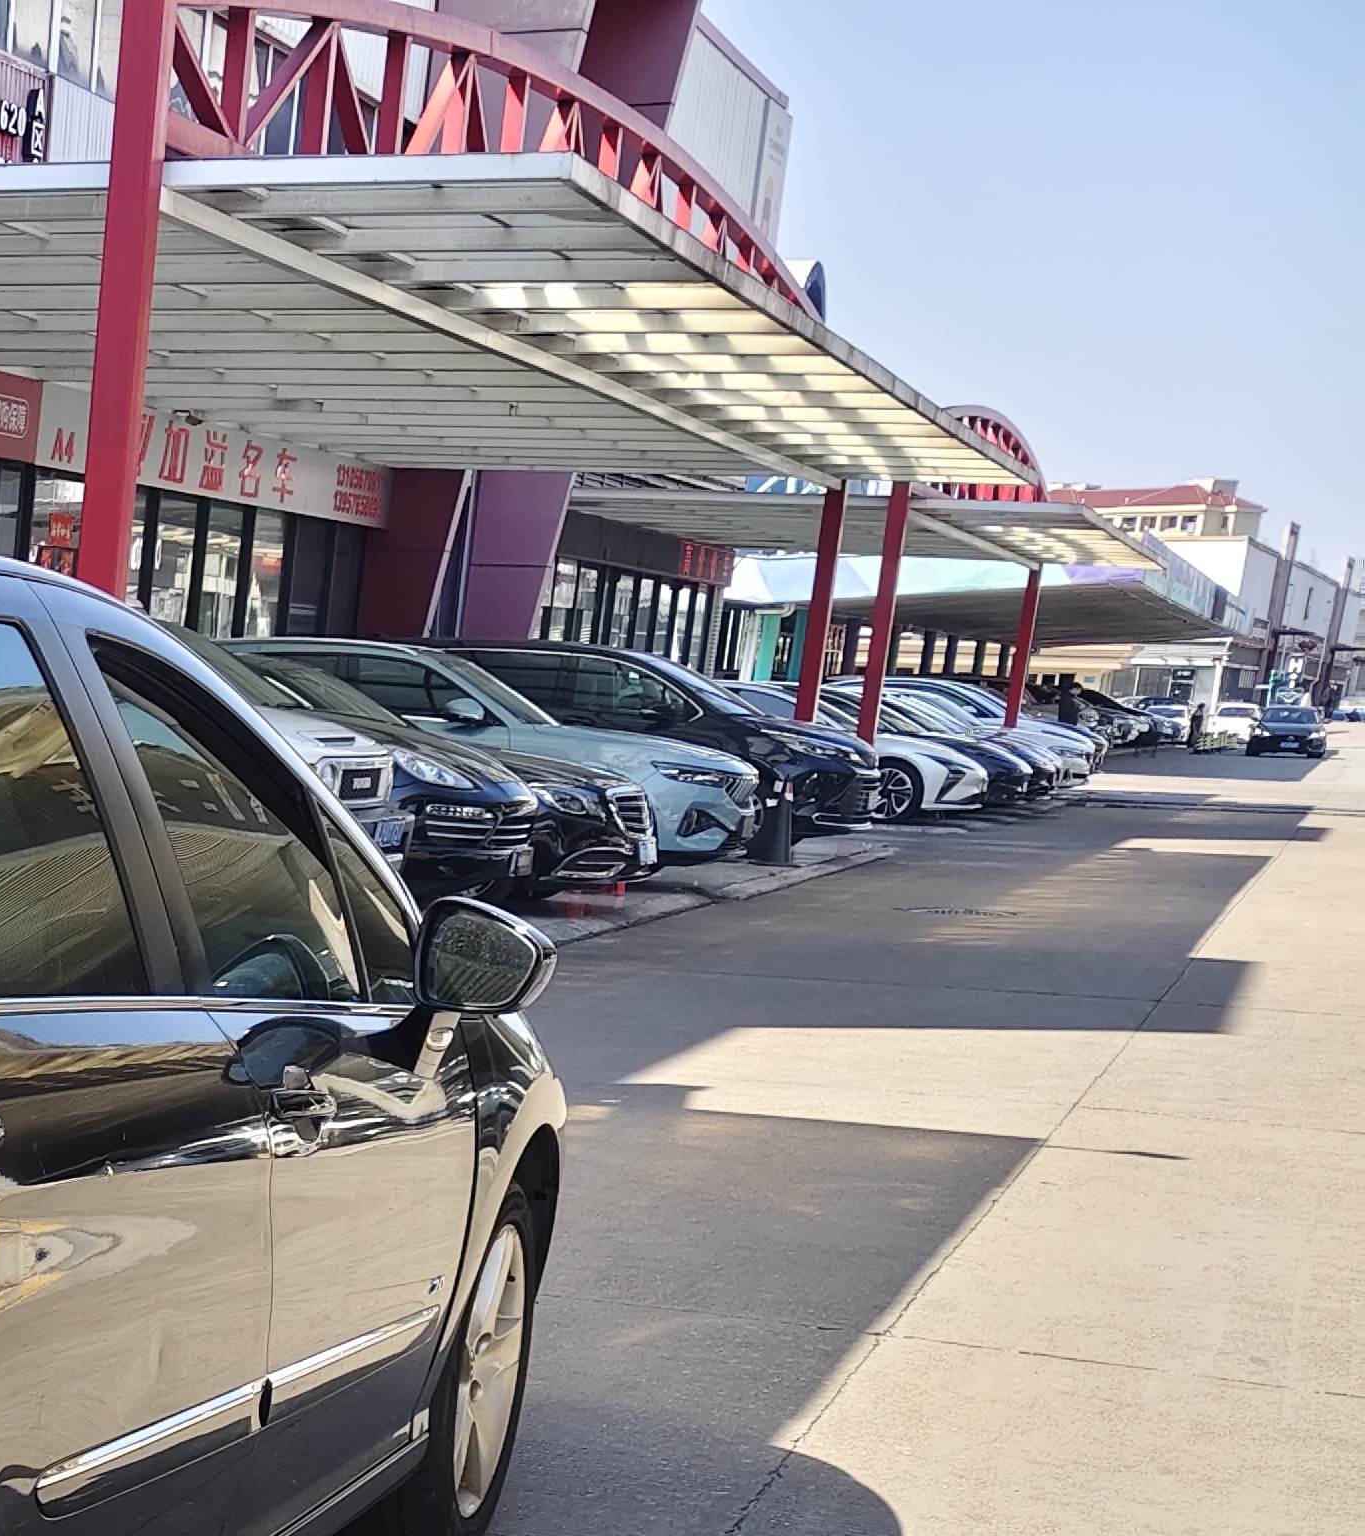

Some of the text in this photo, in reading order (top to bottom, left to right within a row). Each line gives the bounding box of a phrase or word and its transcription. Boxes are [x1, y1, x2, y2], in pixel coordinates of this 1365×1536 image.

[31, 87, 46, 163] A区
[51, 427, 76, 464] A4
[137, 413, 298, 503] 加溢名车
